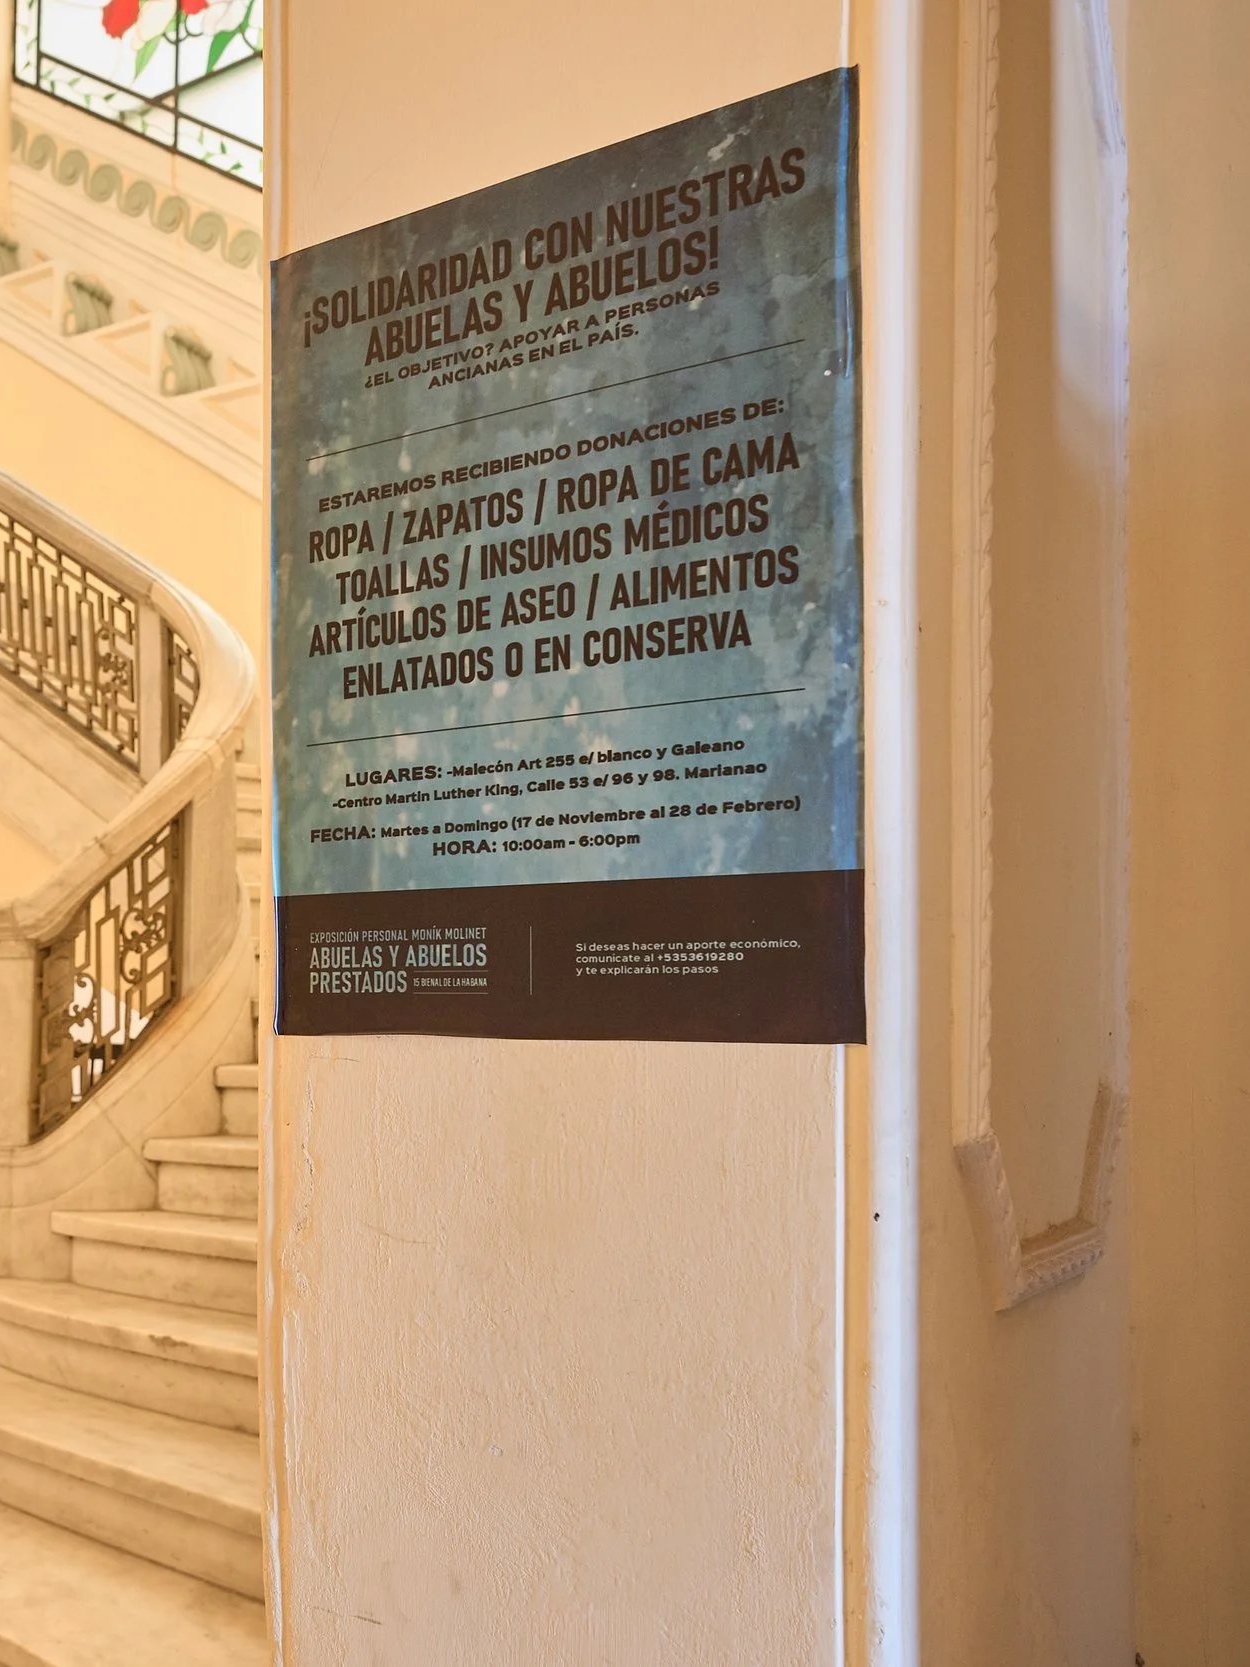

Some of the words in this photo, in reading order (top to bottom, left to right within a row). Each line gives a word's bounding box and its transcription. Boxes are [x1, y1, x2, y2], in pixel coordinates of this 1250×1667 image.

[304, 238, 512, 348] ¡SOLIDARIDAD
[524, 211, 593, 270] CON
[606, 147, 806, 247] NUESTRAS
[364, 290, 503, 367] ABUELAS
[513, 279, 534, 323] Y
[544, 225, 719, 316] ABUELOS!
[364, 371, 394, 389] ¿EL
[398, 342, 494, 380] OBJETIVO?
[499, 319, 579, 352] APOYAR
[584, 314, 600, 330] A
[605, 280, 720, 323] PERSONAS
[428, 353, 524, 390] ANCIANAS
[528, 343, 554, 363] EN
[558, 335, 583, 355] EL
[587, 321, 639, 348] PAÍS.
[319, 474, 436, 513] ESTAREMOS
[441, 443, 571, 486] RECIBIENDO
[577, 407, 736, 457] DONACIONES
[743, 397, 785, 421] DE:
[309, 519, 375, 563] ROPA
[382, 510, 394, 555] /
[402, 488, 524, 546] ZAPATOS
[534, 478, 547, 526] /
[557, 464, 639, 515] ROPA
[650, 452, 691, 497] DE
[702, 431, 800, 487] CAMA
[335, 553, 450, 605] TOALLAS
[459, 544, 472, 591] /
[480, 522, 612, 581] INSUMOS
[624, 493, 769, 556] MÉDICOS
[308, 603, 447, 658] ARTÍCULOS
[457, 595, 491, 635] DE
[500, 581, 576, 628] ASEO
[586, 572, 600, 621] /
[609, 544, 800, 611] ALIMENTOS
[343, 646, 494, 700] ENLATADOS
[504, 641, 524, 678] O
[534, 633, 571, 674] EN
[583, 609, 752, 668] CONSERVA
[332, 796, 383, 809] -Centro
[433, 786, 482, 801] Luther
[485, 783, 523, 798] King,
[526, 779, 566, 793] Calle
[569, 776, 590, 789] 53
[593, 774, 609, 787] e/
[612, 772, 634, 785] 96
[637, 772, 649, 785] y
[652, 768, 680, 782] 98.
[684, 762, 768, 780] Marianao
[345, 765, 443, 787] LUGARES:
[446, 760, 513, 777] -Malecón
[517, 757, 542, 771] Art
[545, 754, 575, 769] 255
[578, 751, 594, 765] e/
[597, 748, 653, 764] blanco
[656, 747, 668, 760] y
[671, 739, 745, 756] Galeano
[310, 826, 376, 843] FECHA:
[380, 823, 429, 839] Martes
[432, 823, 441, 834] a
[444, 817, 508, 834] Domingo
[511, 815, 532, 831] (17
[535, 814, 555, 827] de
[558, 809, 646, 826] Noviembre
[649, 806, 666, 819] al
[669, 804, 692, 818] 28
[695, 802, 718, 816] de
[722, 795, 801, 813] Febrero)
[432, 839, 497, 856] HORA:
[502, 836, 566, 852] 10:00am
[578, 833, 641, 848] 6:00pm
[309, 928, 359, 944] EXPOSICIÓN
[361, 929, 409, 942] PERSONAL
[411, 925, 442, 941] MONÍK
[445, 927, 487, 940] MOLINET
[309, 945, 383, 969] ABUELAS
[388, 944, 400, 968] Y
[405, 943, 487, 967] ABUELOS
[575, 942, 587, 952] Si
[588, 941, 630, 951] deseas
[632, 940, 665, 951] hacer
[667, 941, 684, 950] un
[686, 940, 726, 952] aporte
[729, 938, 802, 949] económico,
[643, 952, 654, 962] al
[657, 951, 744, 962] +5353619280
[309, 970, 408, 994] PRESTADOS
[413, 977, 420, 987] 15
[421, 977, 443, 987] BIENAL
[443, 977, 451, 987] DE
[452, 977, 461, 987] LA
[461, 977, 488, 987] HABANA
[575, 966, 583, 976] y
[585, 965, 598, 975] te
[599, 964, 660, 976] explicarán
[661, 964, 680, 974] los
[682, 965, 719, 976] pasos
